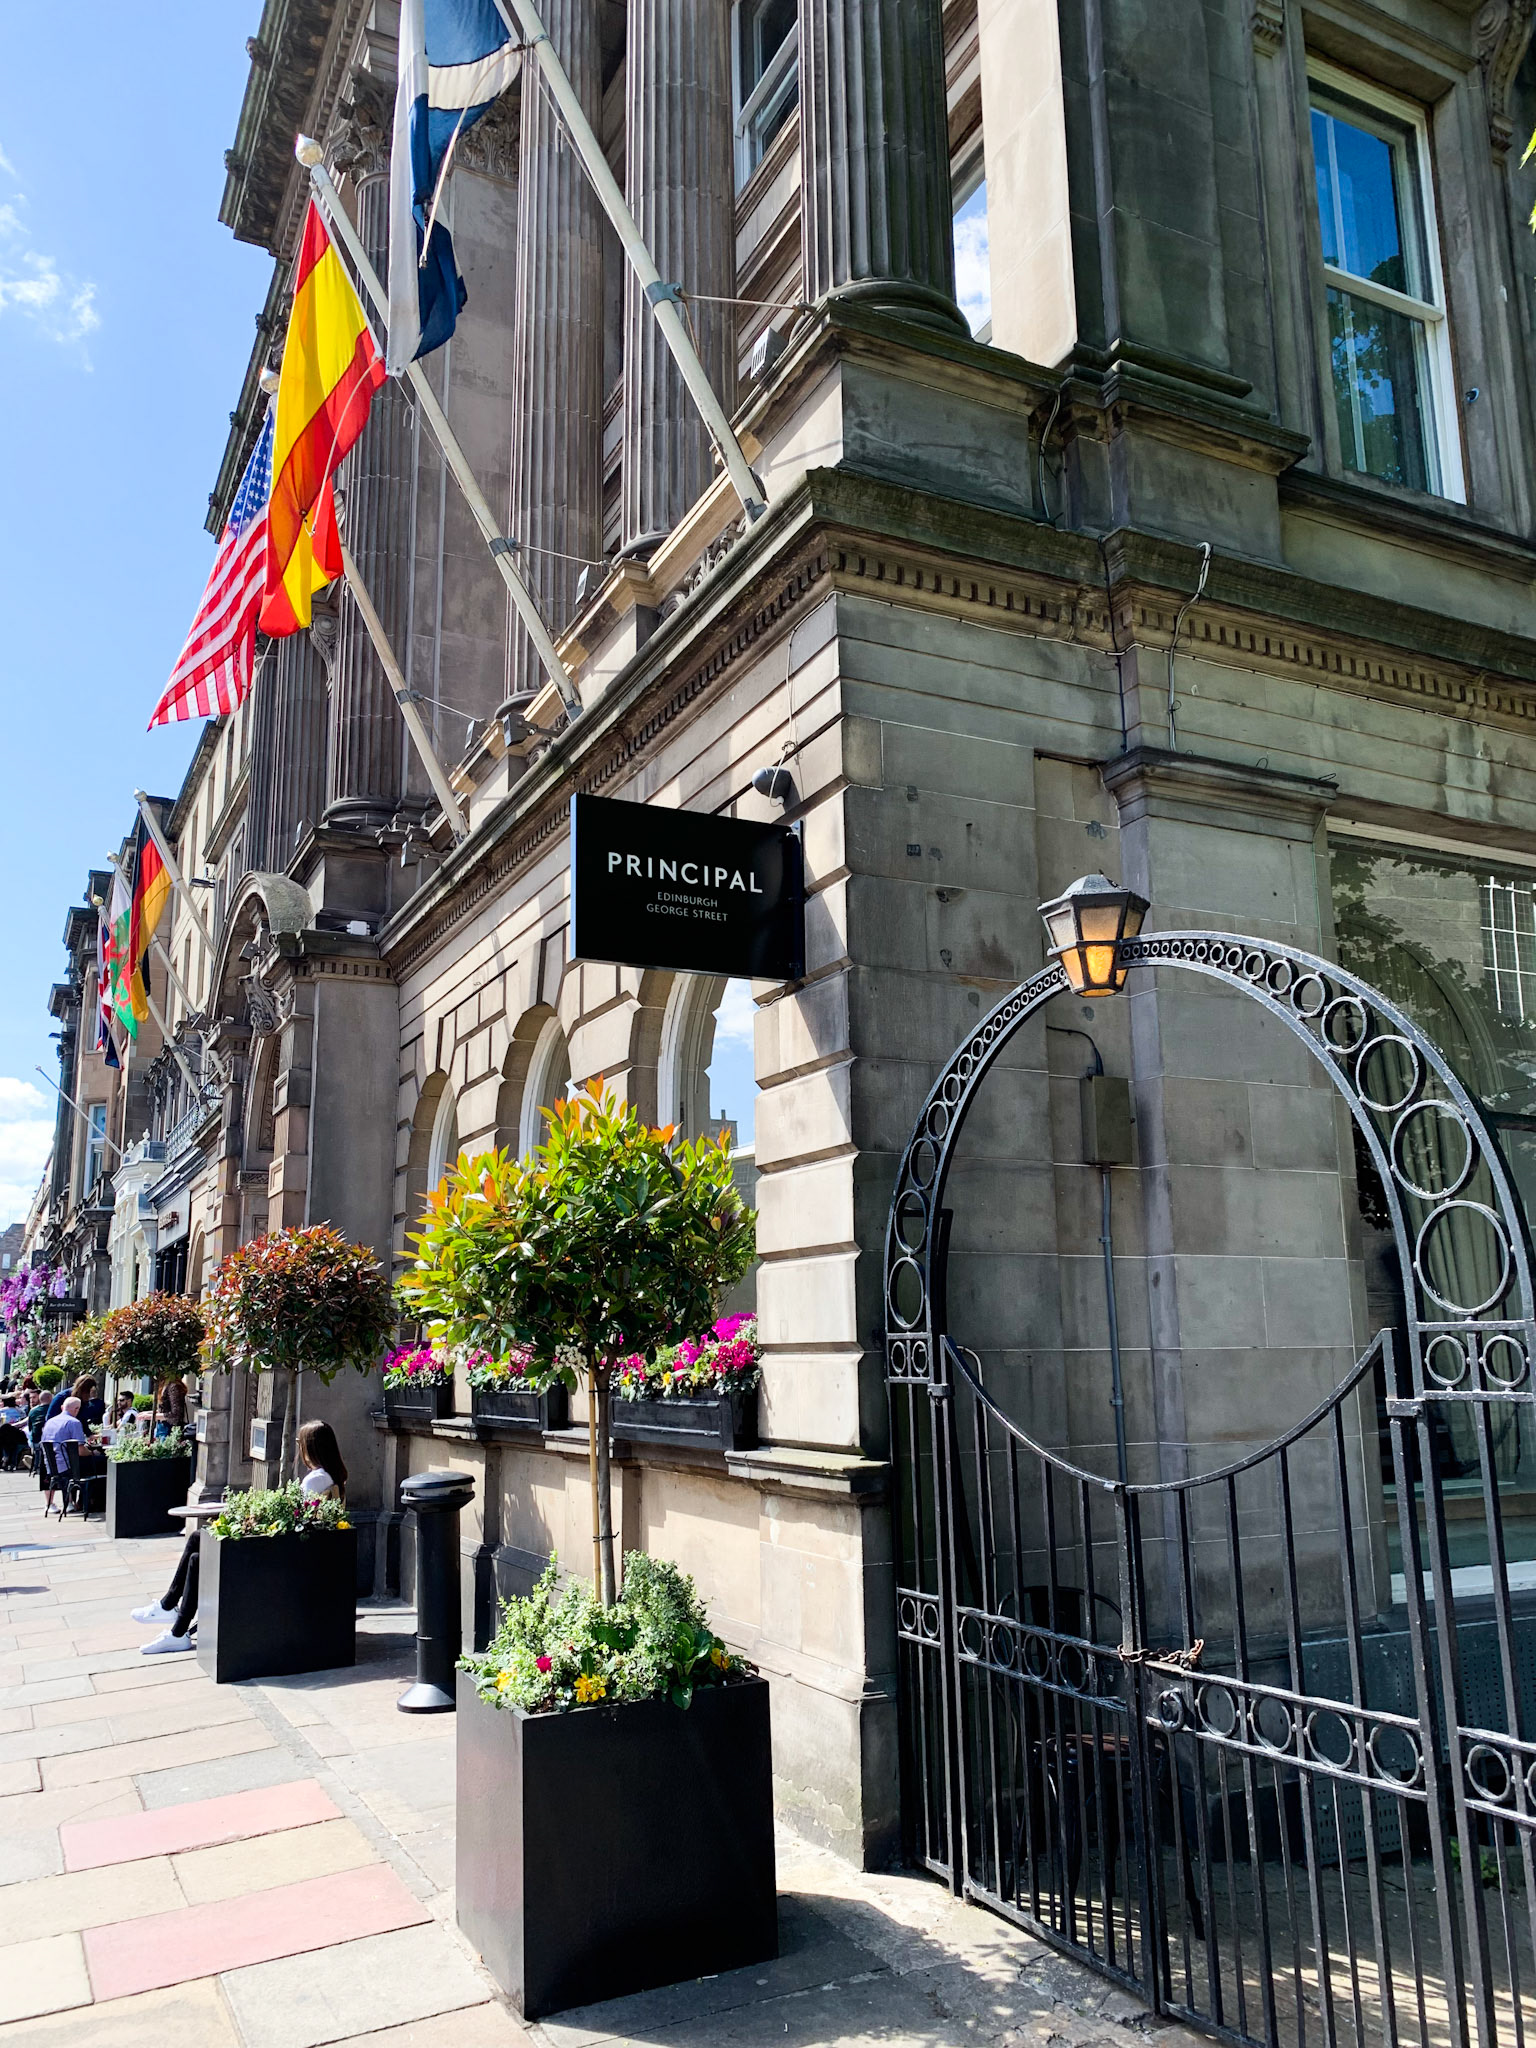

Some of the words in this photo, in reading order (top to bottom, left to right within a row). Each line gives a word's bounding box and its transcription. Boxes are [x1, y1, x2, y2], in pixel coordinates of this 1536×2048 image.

[608, 851, 763, 894] PRINCIPAL
[657, 891, 718, 908] EDINBURGH
[646, 903, 689, 917] GEORGE
[692, 909, 728, 922] STREET
